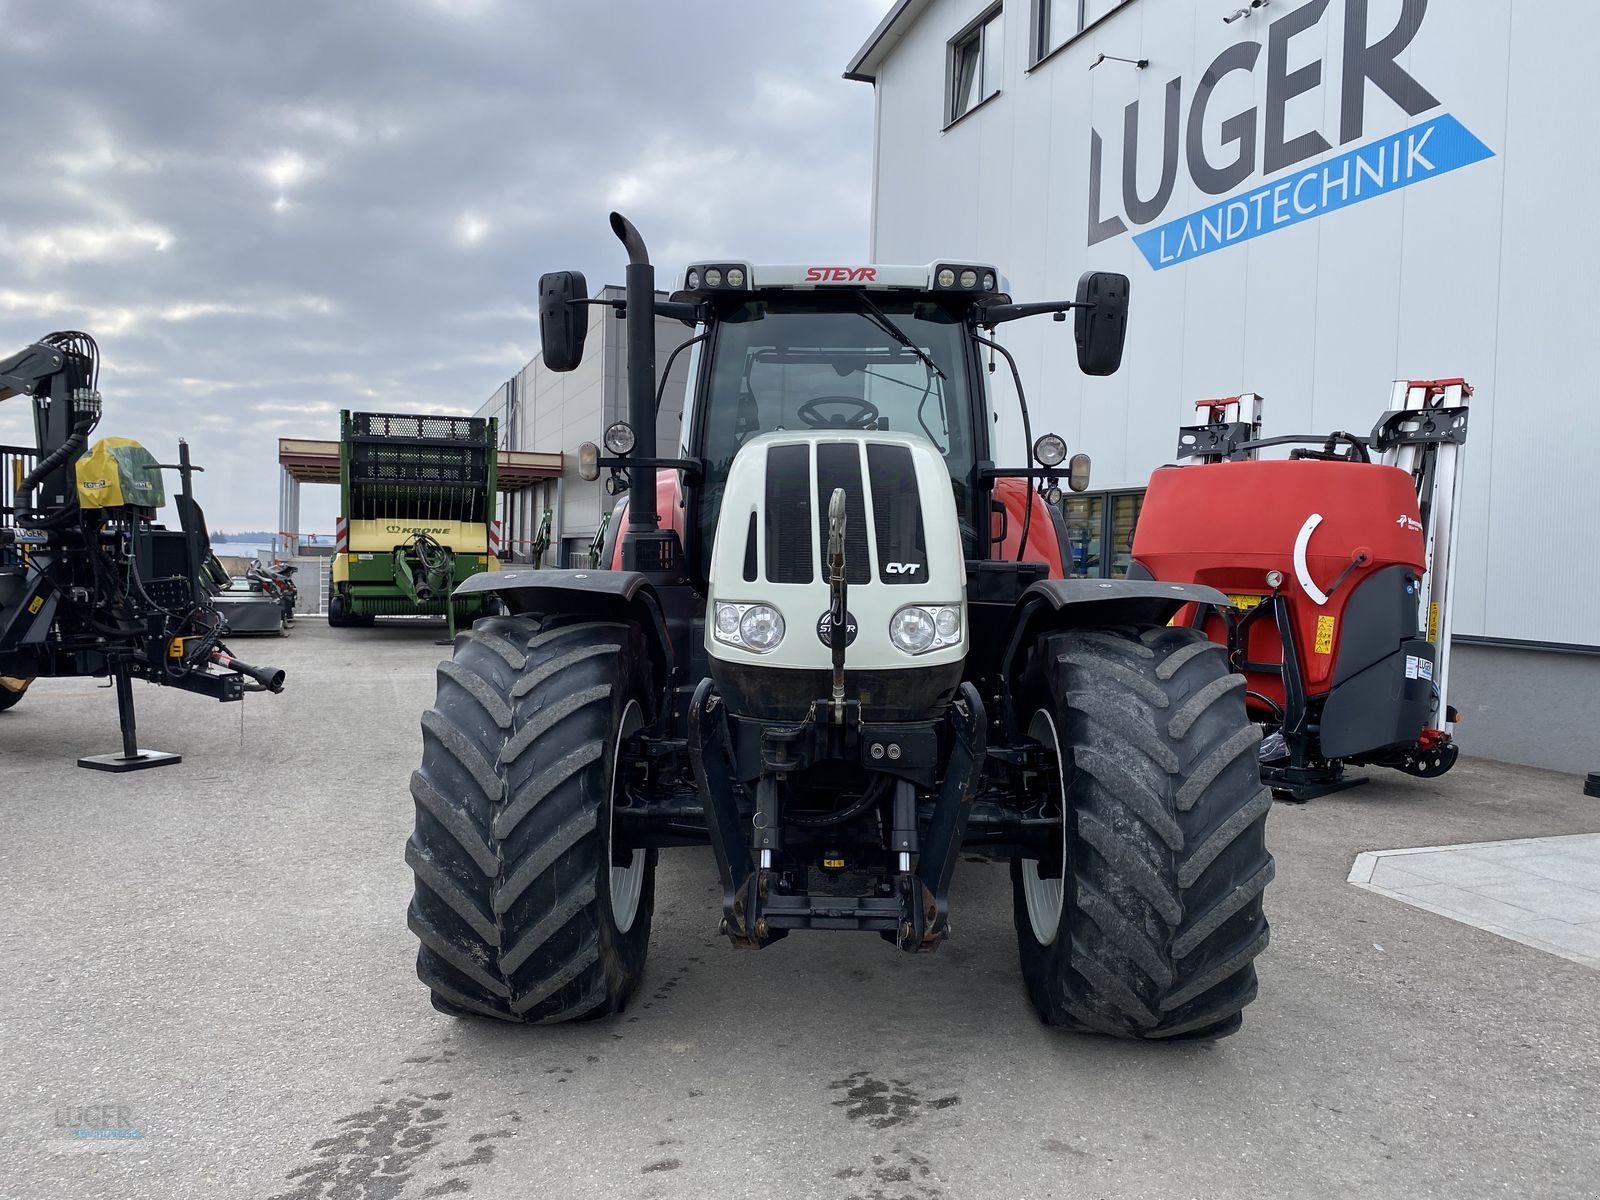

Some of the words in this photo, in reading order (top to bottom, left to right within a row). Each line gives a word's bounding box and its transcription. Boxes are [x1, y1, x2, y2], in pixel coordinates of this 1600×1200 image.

[1088, 0, 1442, 247] LUGER
[1159, 126, 1436, 264] LANDTECHNIK
[804, 267, 877, 282] STEYR
[401, 527, 451, 535] KRONE
[885, 562, 920, 575] CVT
[818, 624, 856, 633] STR
